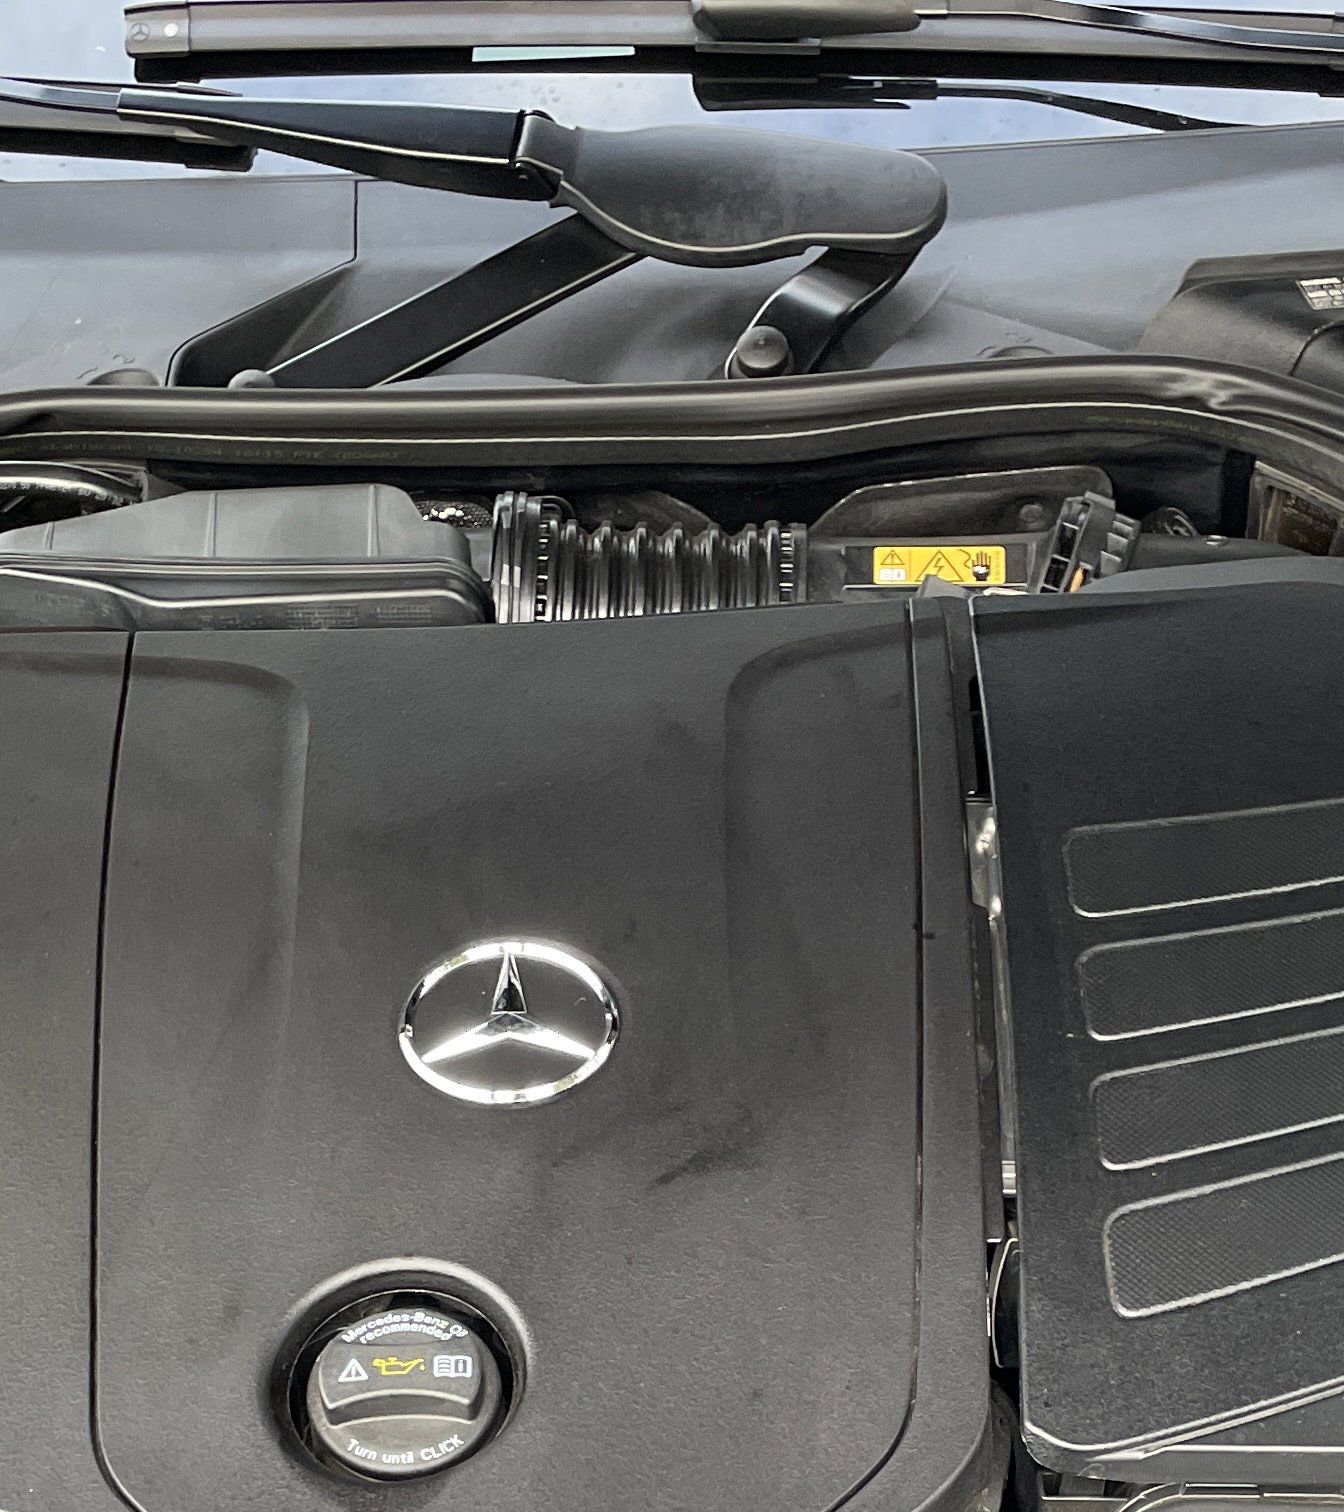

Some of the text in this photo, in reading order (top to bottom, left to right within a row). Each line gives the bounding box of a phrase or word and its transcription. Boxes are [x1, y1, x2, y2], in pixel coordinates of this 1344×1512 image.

[341, 1311, 449, 1344] Mercedes-Benz
[359, 1323, 453, 1344] recommended
[346, 1433, 464, 1465] Turn until CLICK
